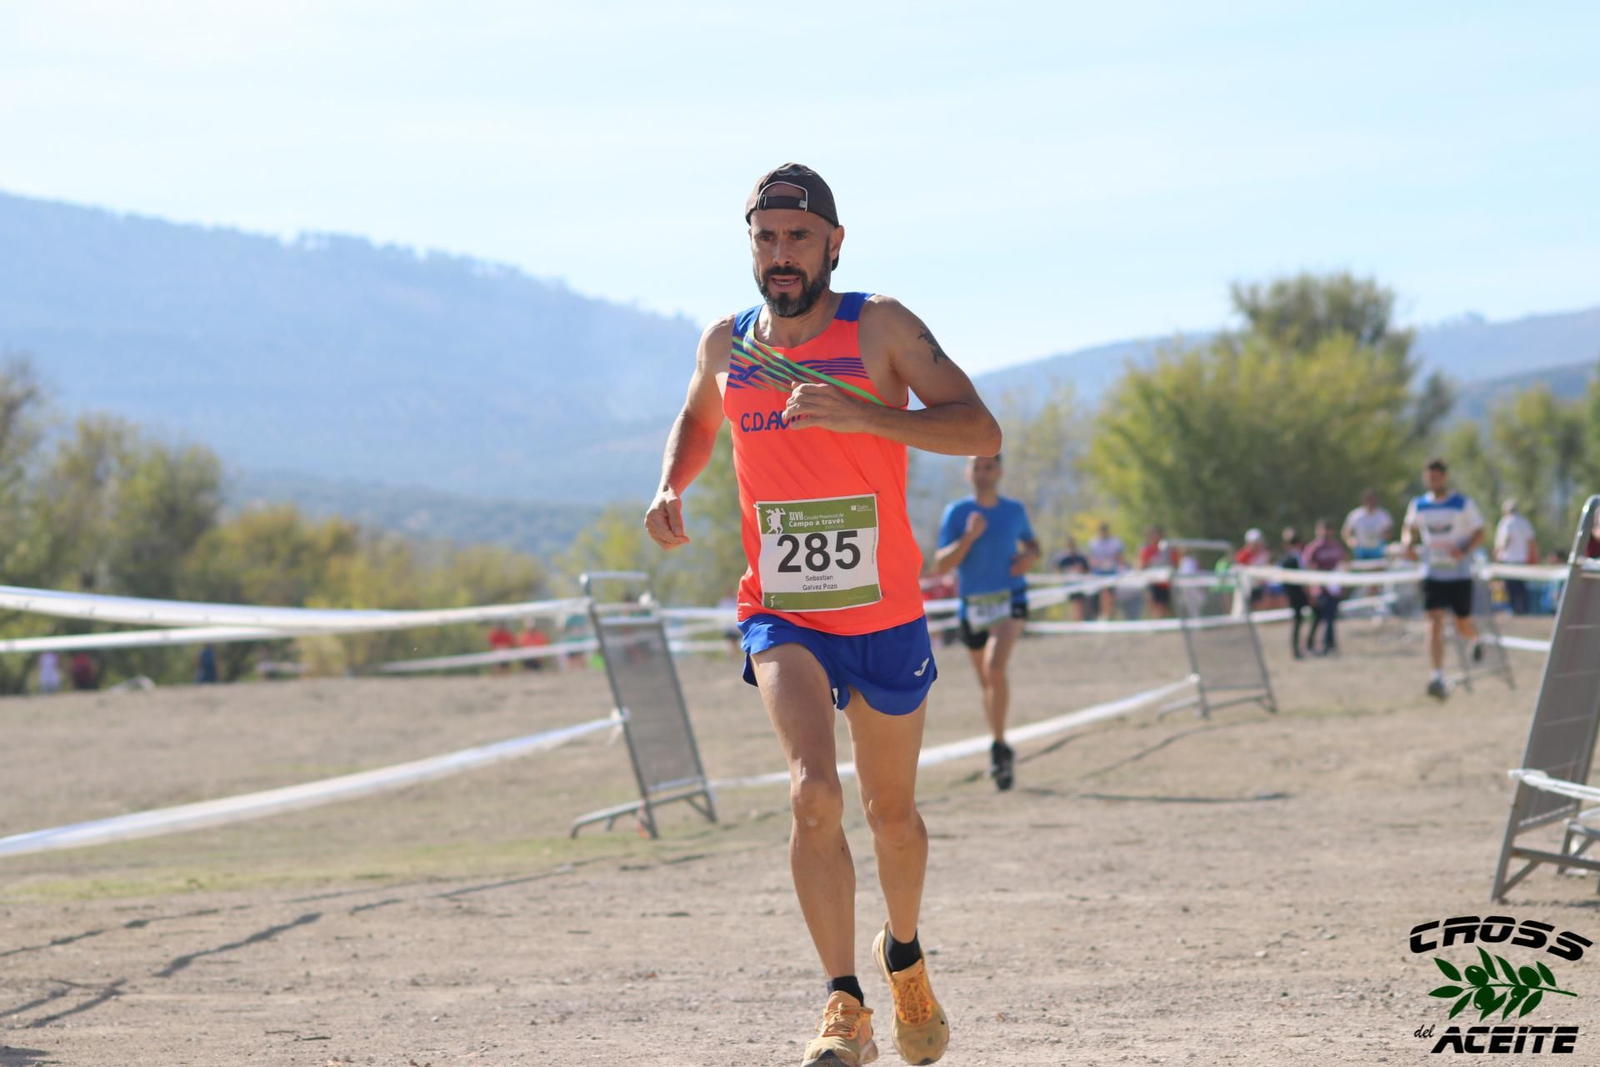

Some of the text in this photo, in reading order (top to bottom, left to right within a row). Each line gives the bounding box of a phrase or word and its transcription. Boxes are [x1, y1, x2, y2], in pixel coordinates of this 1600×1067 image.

[777, 530, 861, 573] 285
[805, 574, 834, 582] Sebastian
[802, 583, 822, 591] Galvez
